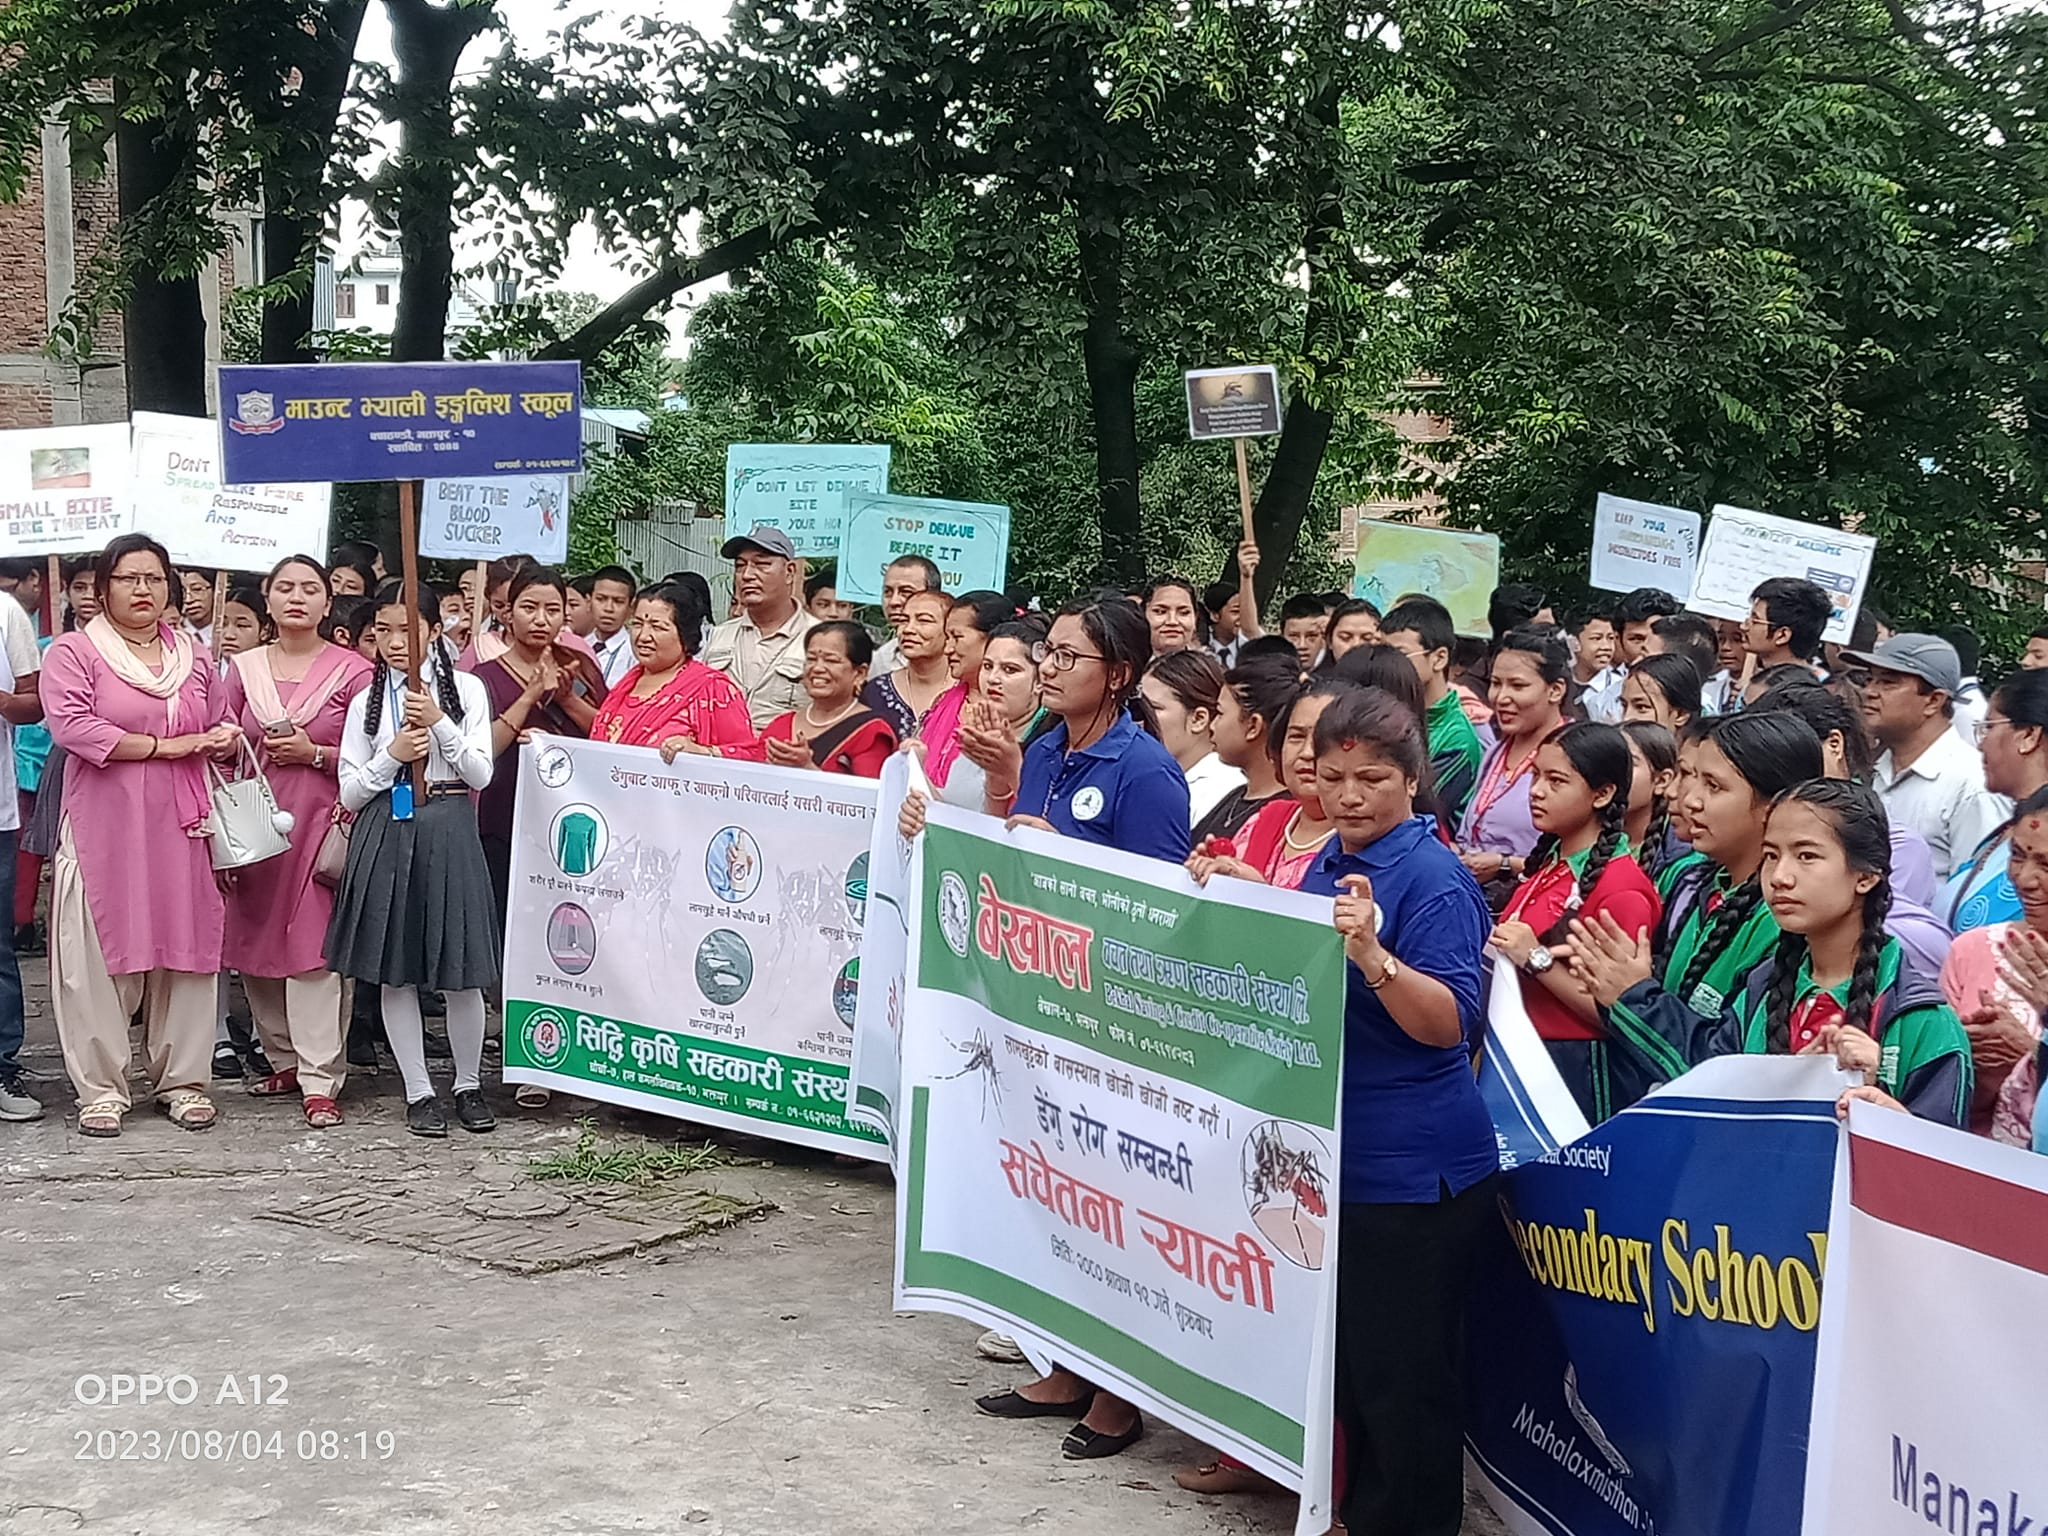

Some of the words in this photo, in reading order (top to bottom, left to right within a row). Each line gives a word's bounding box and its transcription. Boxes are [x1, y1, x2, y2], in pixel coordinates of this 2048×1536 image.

[284, 398, 352, 419] माउन्ट
[360, 389, 426, 418] भ्याली
[434, 388, 512, 423] इङ्गलिश
[519, 391, 574, 419] स्कूल
[0, 501, 55, 520] SMALL
[66, 497, 113, 515] BITE
[264, 486, 304, 501] FIRE
[438, 481, 474, 503] BEAT
[480, 486, 510, 506] THE
[9, 520, 43, 536] BIG
[51, 514, 121, 533] THREAT
[205, 509, 236, 525] AND
[450, 504, 491, 524] BLOOD
[788, 518, 816, 530] YOUR
[884, 517, 924, 533] STOP
[928, 521, 975, 539] DENGUE
[444, 522, 502, 545] SUCKER
[889, 540, 934, 557] BEFORE
[938, 547, 962, 561] IT
[610, 765, 648, 789] डेंगुबाट
[683, 780, 690, 793] र
[734, 784, 789, 810] परिवारलाई
[793, 795, 822, 813] यसरी
[827, 800, 866, 819] बचाउन
[976, 872, 1094, 992] बेखाल
[1129, 946, 1155, 983] तथा
[1189, 960, 1250, 1007] सहकारी
[1250, 971, 1291, 1016] संस्था
[575, 1015, 625, 1063] सिद्धि
[631, 1033, 680, 1069] कृषि
[687, 1048, 784, 1091] सहकारी
[791, 1066, 847, 1102] संस्थ
[1105, 1069, 1134, 1100] खोजी
[1140, 1081, 1168, 1113] खोजी
[1173, 1097, 1194, 1124] नष्ट
[1199, 1104, 1221, 1137] गरौं
[1034, 1085, 1065, 1152] डेंगु
[1069, 1104, 1108, 1158] रोग
[1117, 1129, 1194, 1194] सम्बन्धी
[999, 1137, 1126, 1250] सचेतना
[1512, 1207, 1655, 1334] econdary
[1511, 1402, 1639, 1530] Mahalaxmisthan
[1892, 1433, 2048, 1536] Manak
